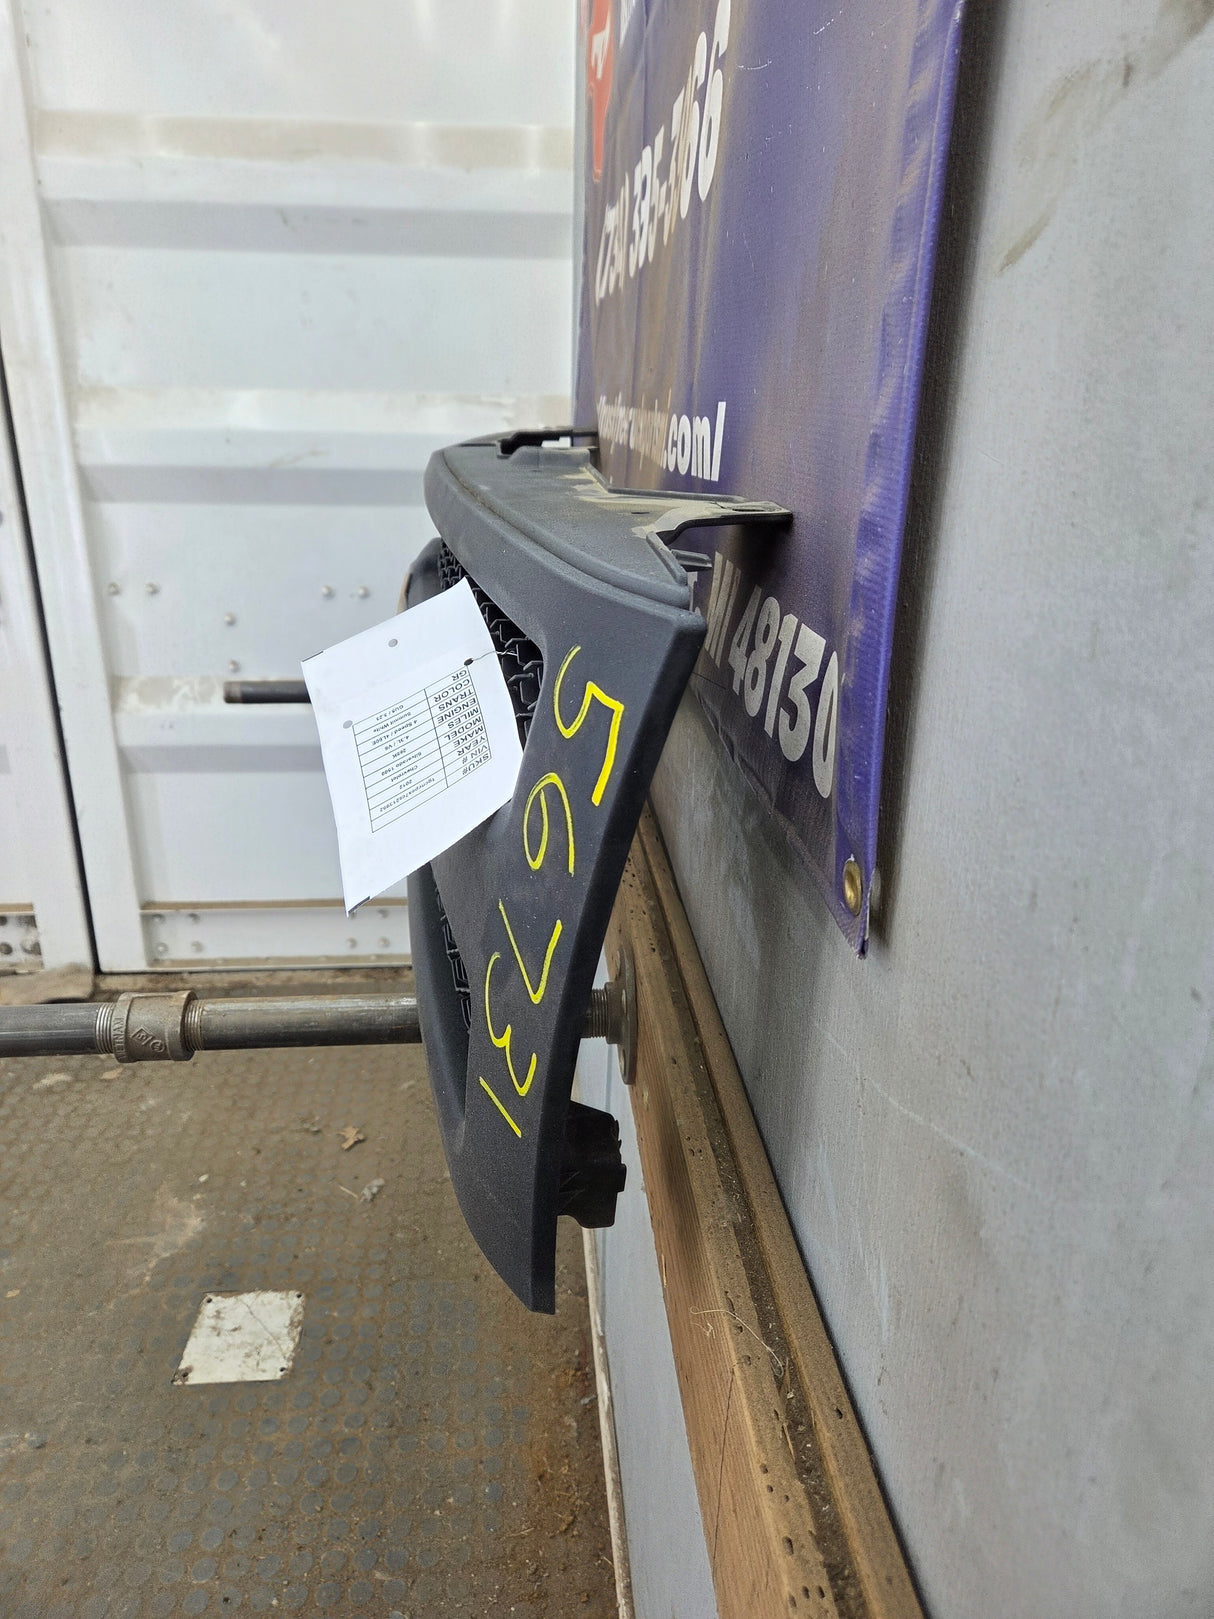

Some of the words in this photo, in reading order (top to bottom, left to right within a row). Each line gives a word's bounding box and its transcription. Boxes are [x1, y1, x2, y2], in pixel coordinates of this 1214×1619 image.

[451, 669, 468, 681] GR
[434, 678, 470, 703] COLOR
[438, 688, 474, 711] TRANS
[728, 584, 839, 799] 48130
[437, 697, 477, 724] ENGINE
[447, 706, 479, 729] MILES
[373, 722, 390, 733] White
[394, 721, 413, 735] Speed
[443, 716, 482, 741] MODEL
[453, 725, 484, 748] MAKE
[457, 735, 486, 757] YEAR
[470, 744, 488, 759] VIN
[395, 751, 422, 768] Silverado
[461, 753, 489, 776] SKU#
[390, 765, 418, 782] Chevrolet
